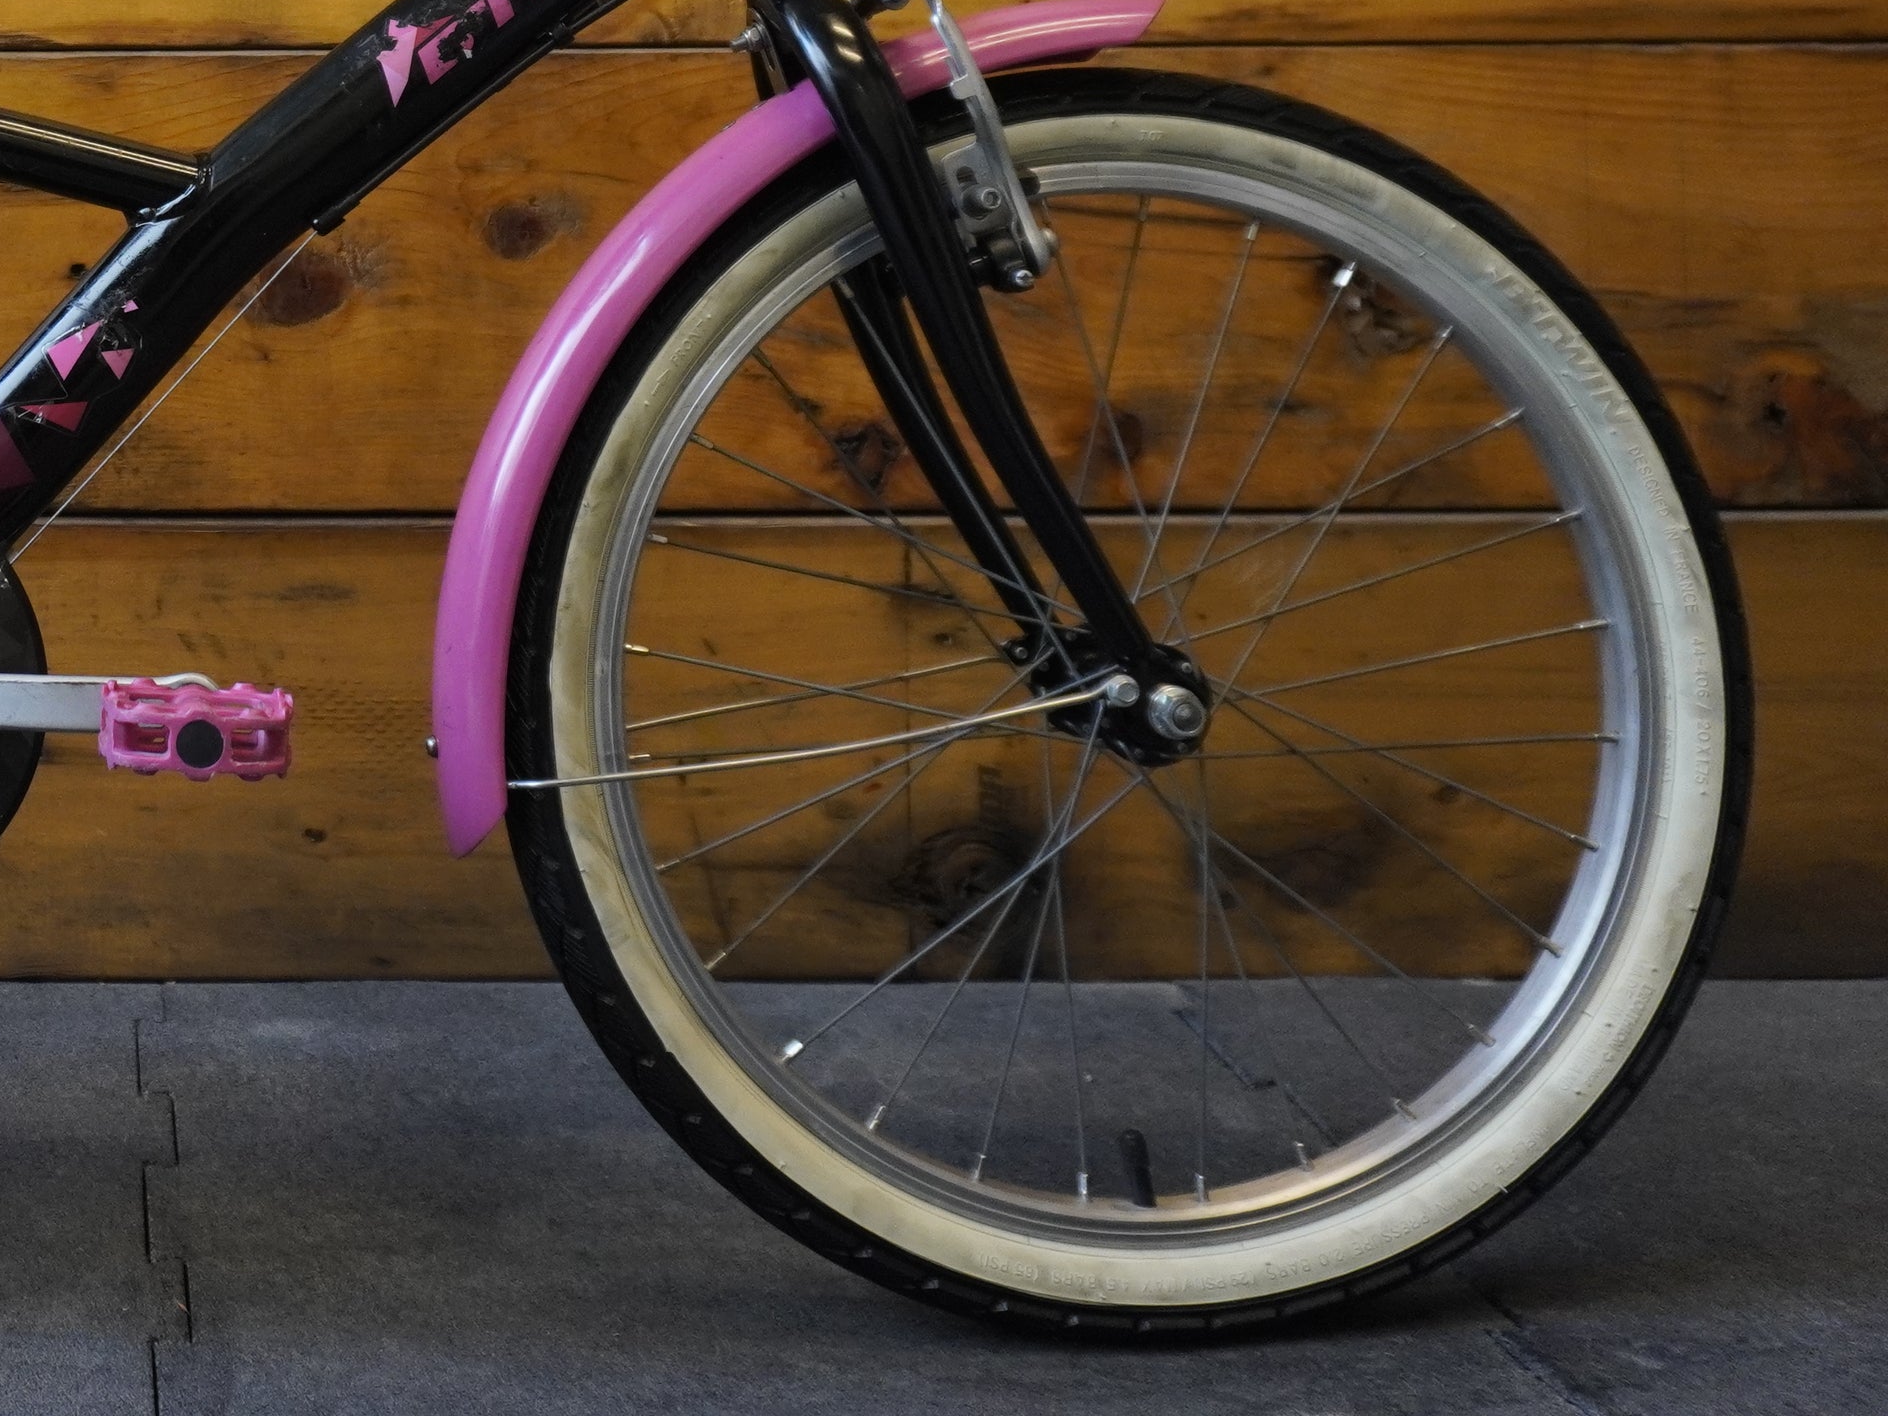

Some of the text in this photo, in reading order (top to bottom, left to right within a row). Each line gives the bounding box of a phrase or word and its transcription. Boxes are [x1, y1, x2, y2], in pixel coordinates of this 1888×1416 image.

[666, 315, 712, 369] FRONT
[1626, 442, 1672, 520] DESIGNED
[1662, 523, 1681, 545] IN
[1670, 547, 1698, 615] FRANCE
[1346, 1208, 1432, 1258] PRESSURE
[1048, 1268, 1098, 1291] BARS
[1262, 1255, 1311, 1285] BARS
